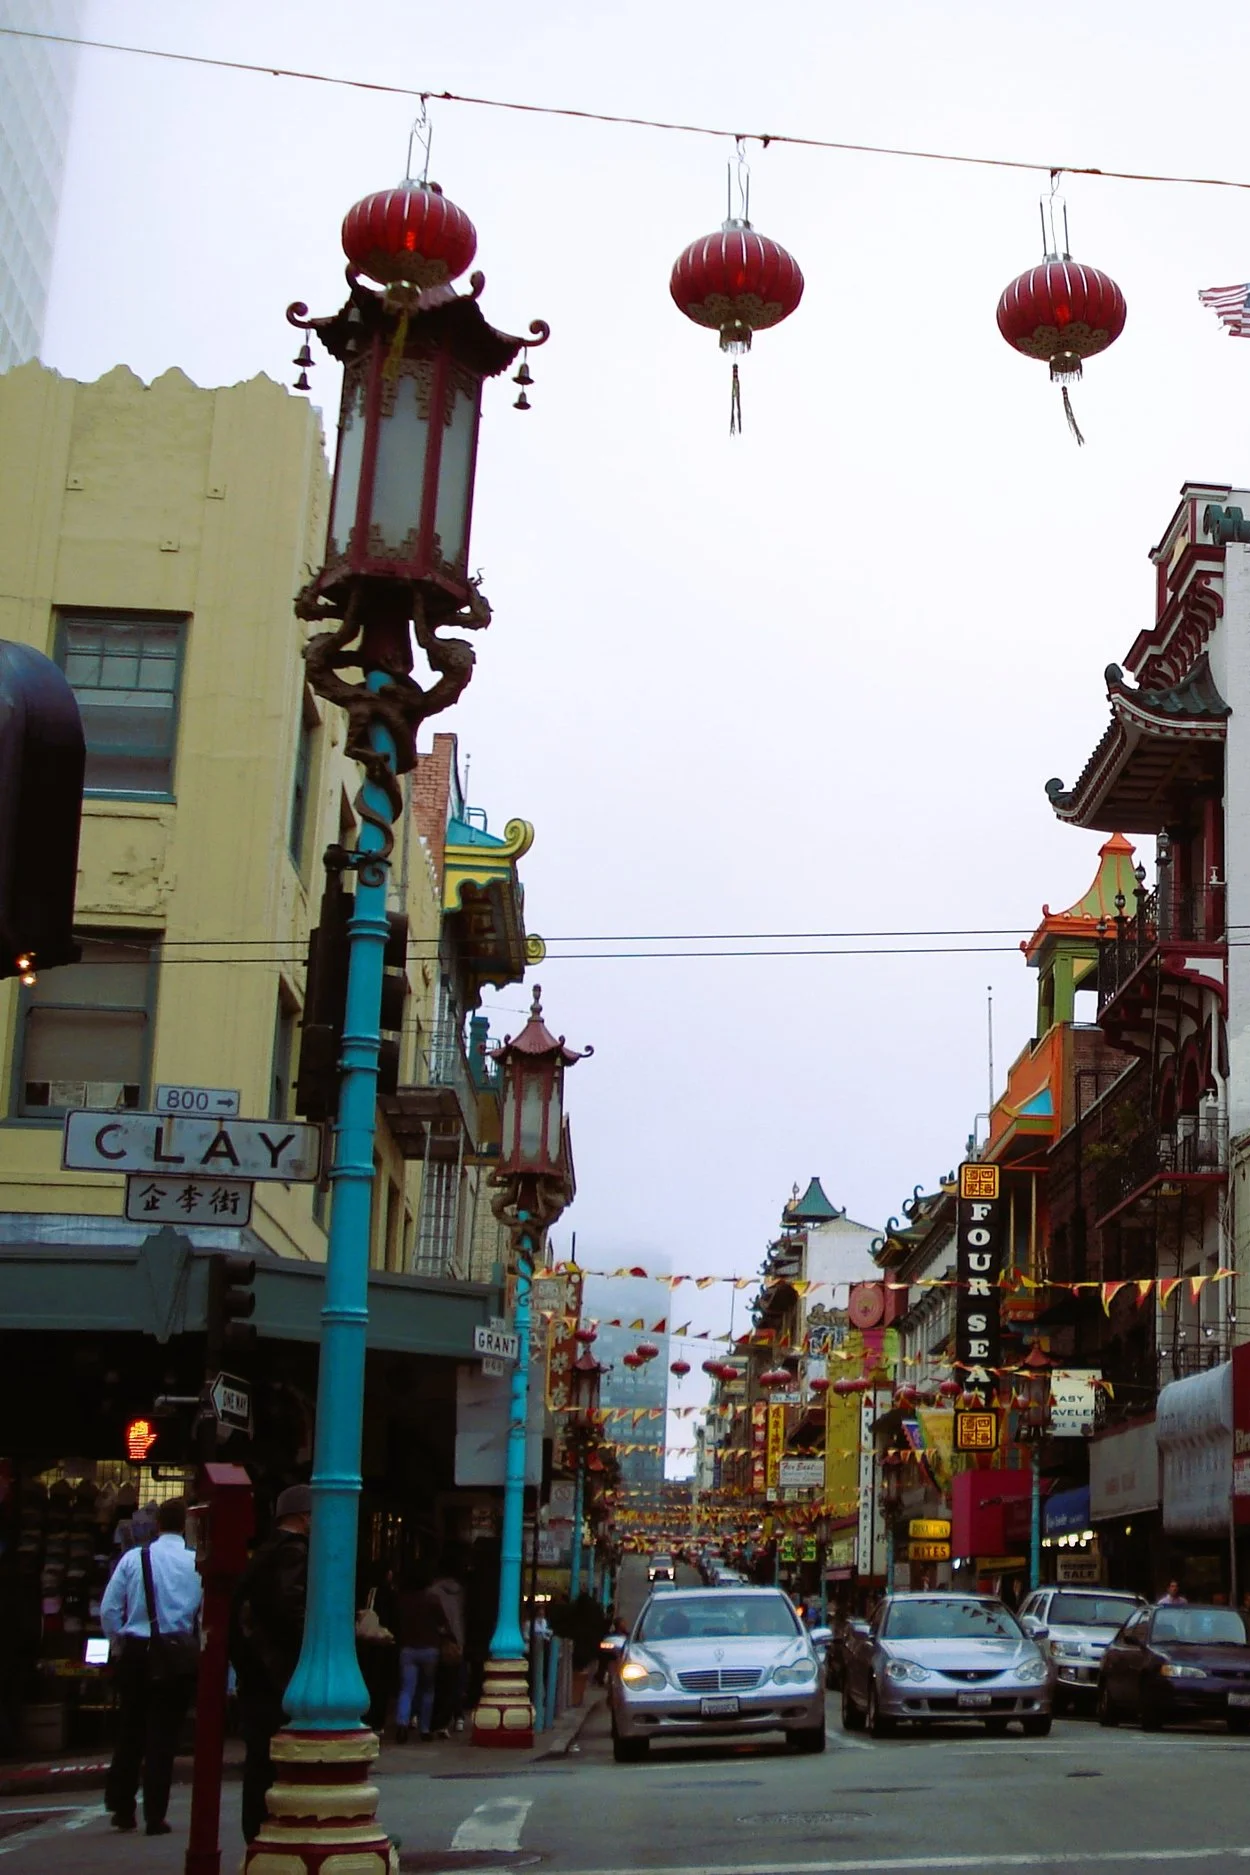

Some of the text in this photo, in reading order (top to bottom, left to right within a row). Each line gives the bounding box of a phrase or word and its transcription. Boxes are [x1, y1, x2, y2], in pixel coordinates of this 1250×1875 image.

[167, 1090, 209, 1110] 800
[95, 1124, 295, 1168] CLAY
[139, 1183, 241, 1215] 企李街
[967, 1203, 992, 1296] FOUR
[478, 1332, 516, 1359] GRANT
[913, 1546, 946, 1558] KITES
[1063, 1570, 1095, 1579] SALE
